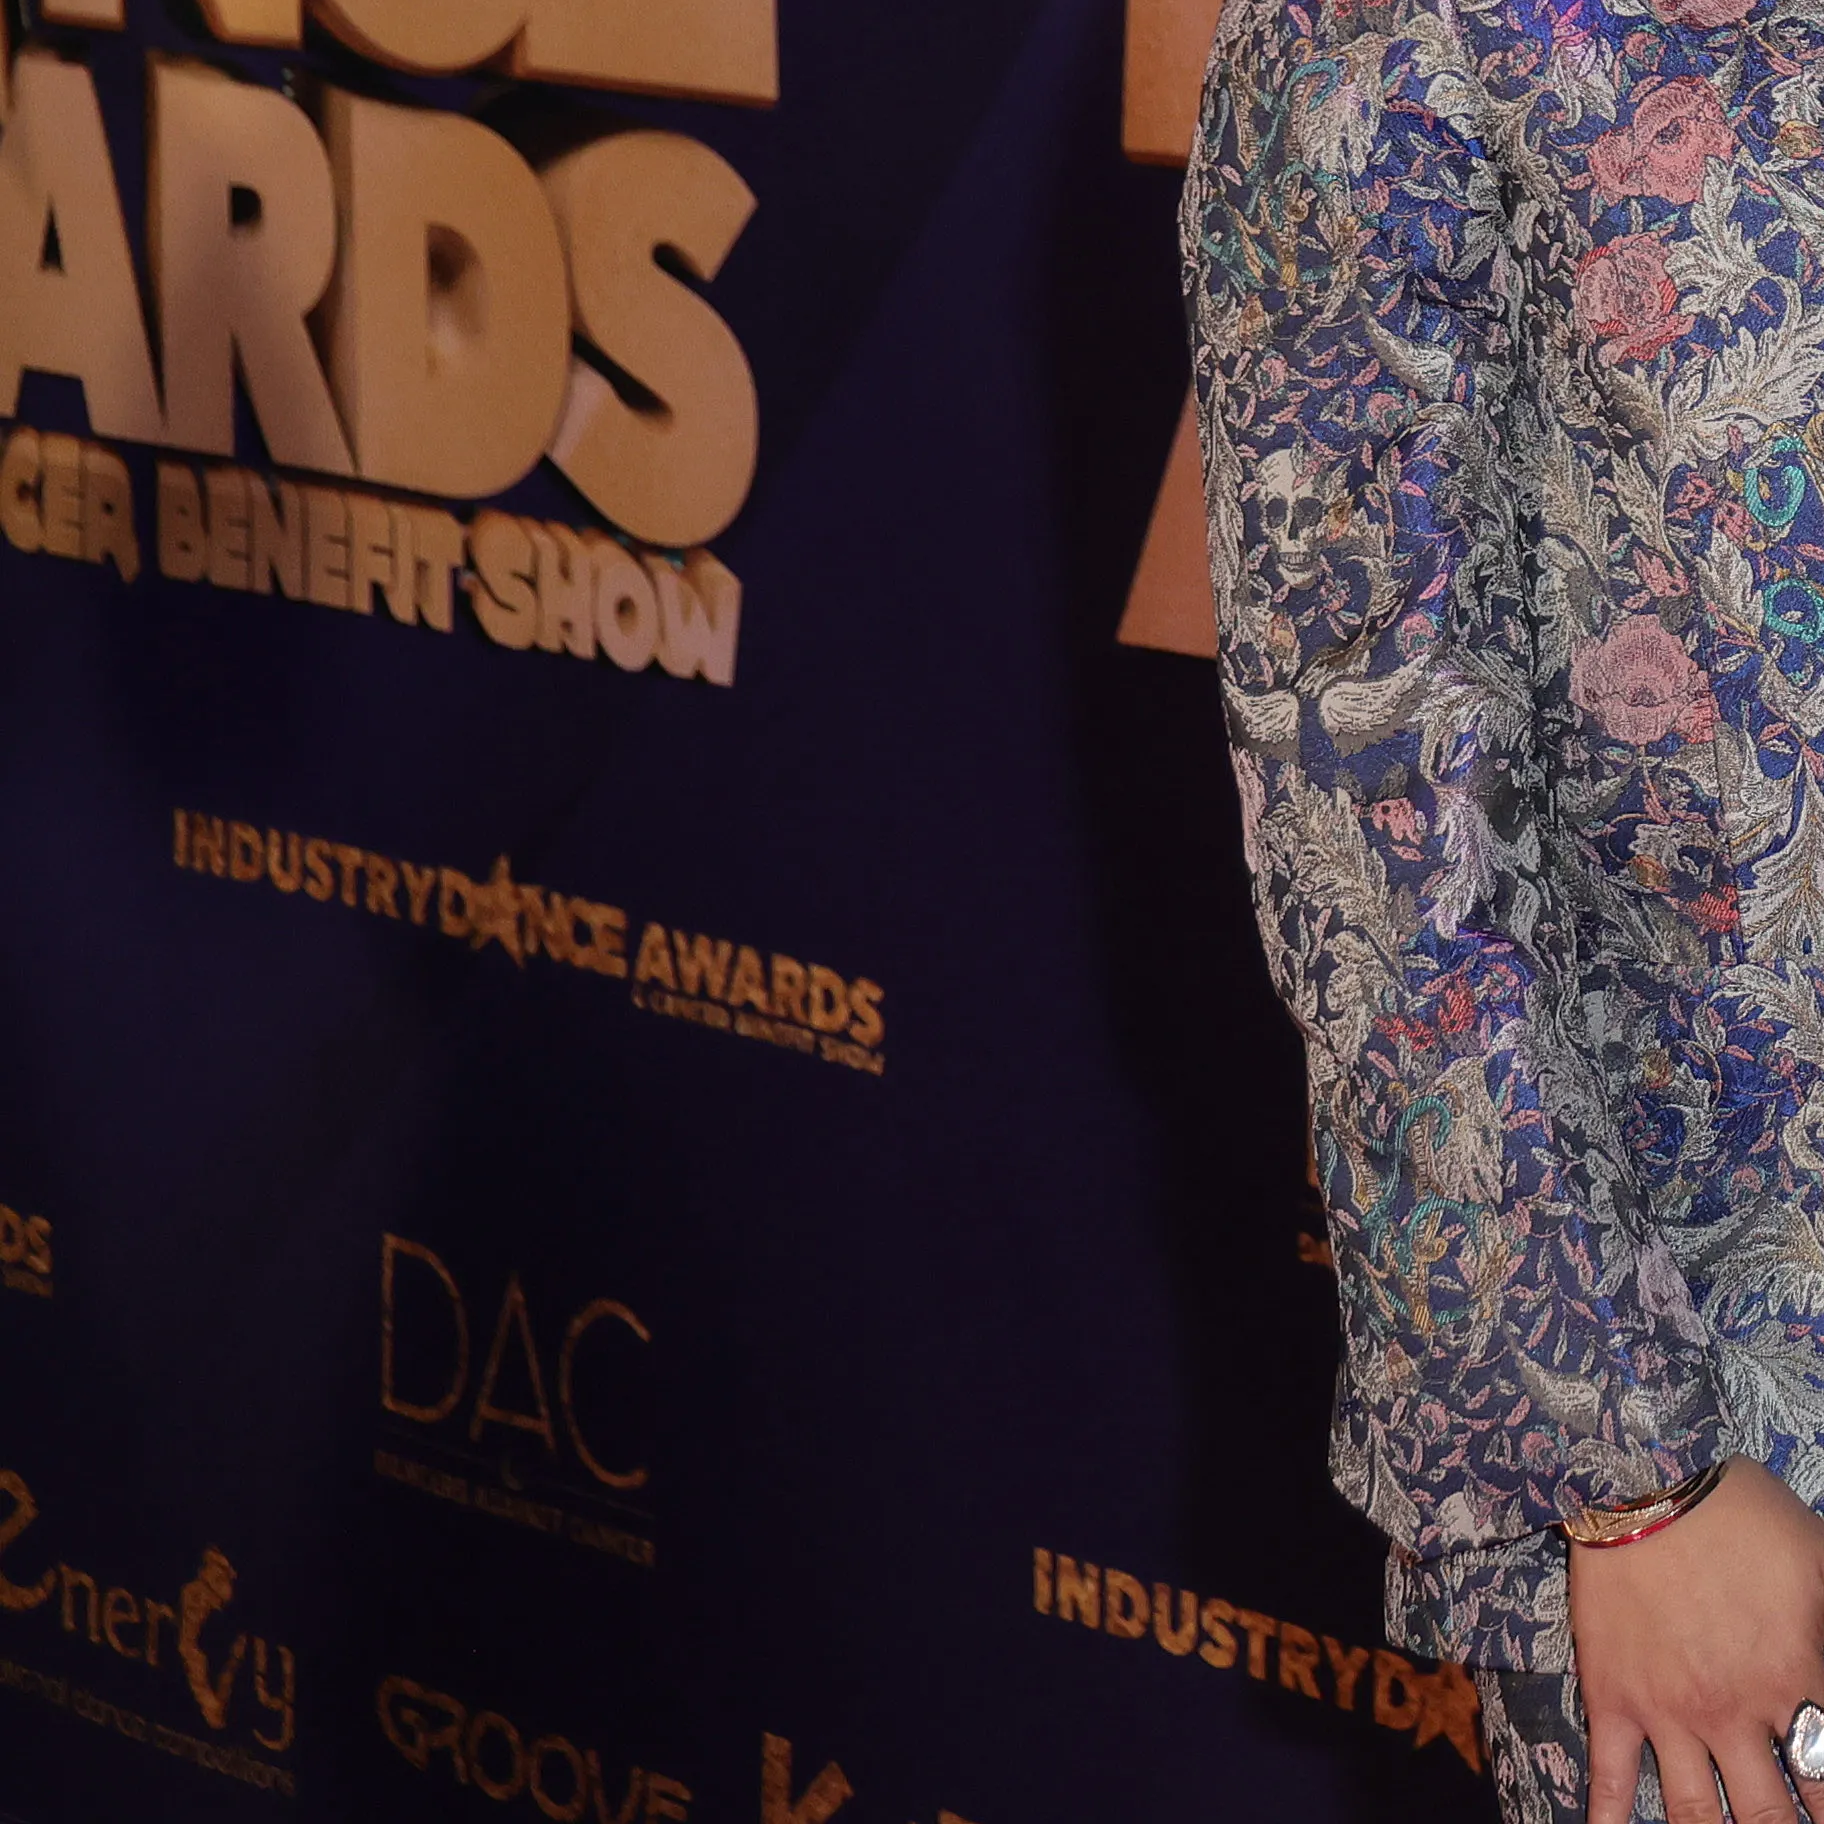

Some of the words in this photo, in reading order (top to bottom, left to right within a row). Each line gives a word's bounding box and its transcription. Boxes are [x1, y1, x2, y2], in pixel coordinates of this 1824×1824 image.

[155, 457, 467, 634] BENEFIT
[460, 507, 744, 689] SHOW
[173, 807, 436, 927] INDUSTRY
[634, 920, 886, 1049] AWARDS
[380, 1231, 652, 1490] DAC
[1033, 1547, 1369, 1712] INDUSTRY
